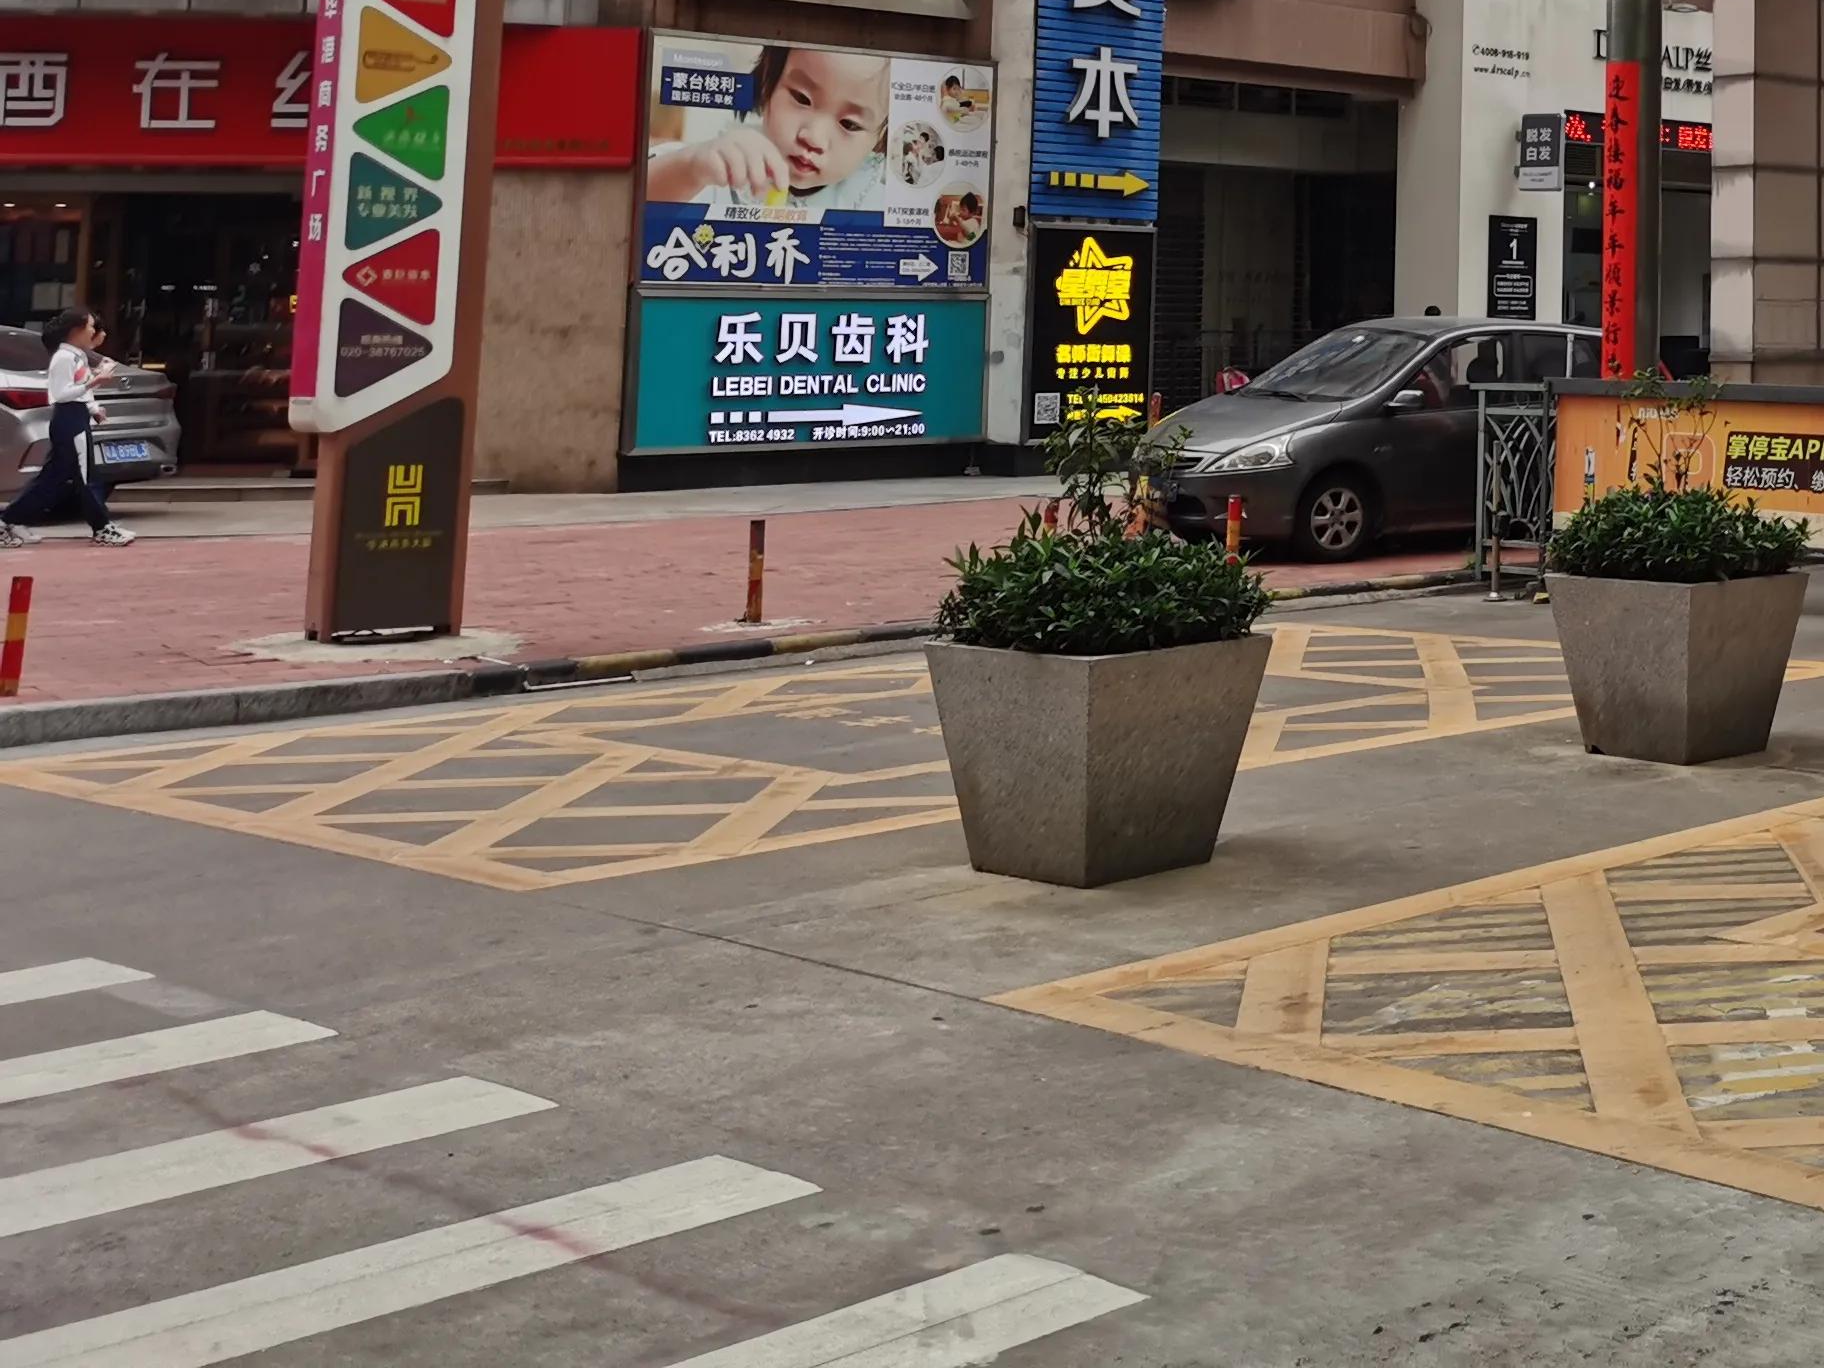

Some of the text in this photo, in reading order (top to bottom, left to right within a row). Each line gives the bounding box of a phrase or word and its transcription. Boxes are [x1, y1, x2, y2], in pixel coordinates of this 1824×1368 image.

[1525, 127, 1553, 144] 脱发
[1525, 146, 1552, 162] 白发
[646, 226, 811, 285] 哈利乔
[1509, 238, 1518, 260] 1
[714, 311, 930, 365] 乐贝齿科
[712, 372, 926, 397] LEBEI DENTAL CLINIC
